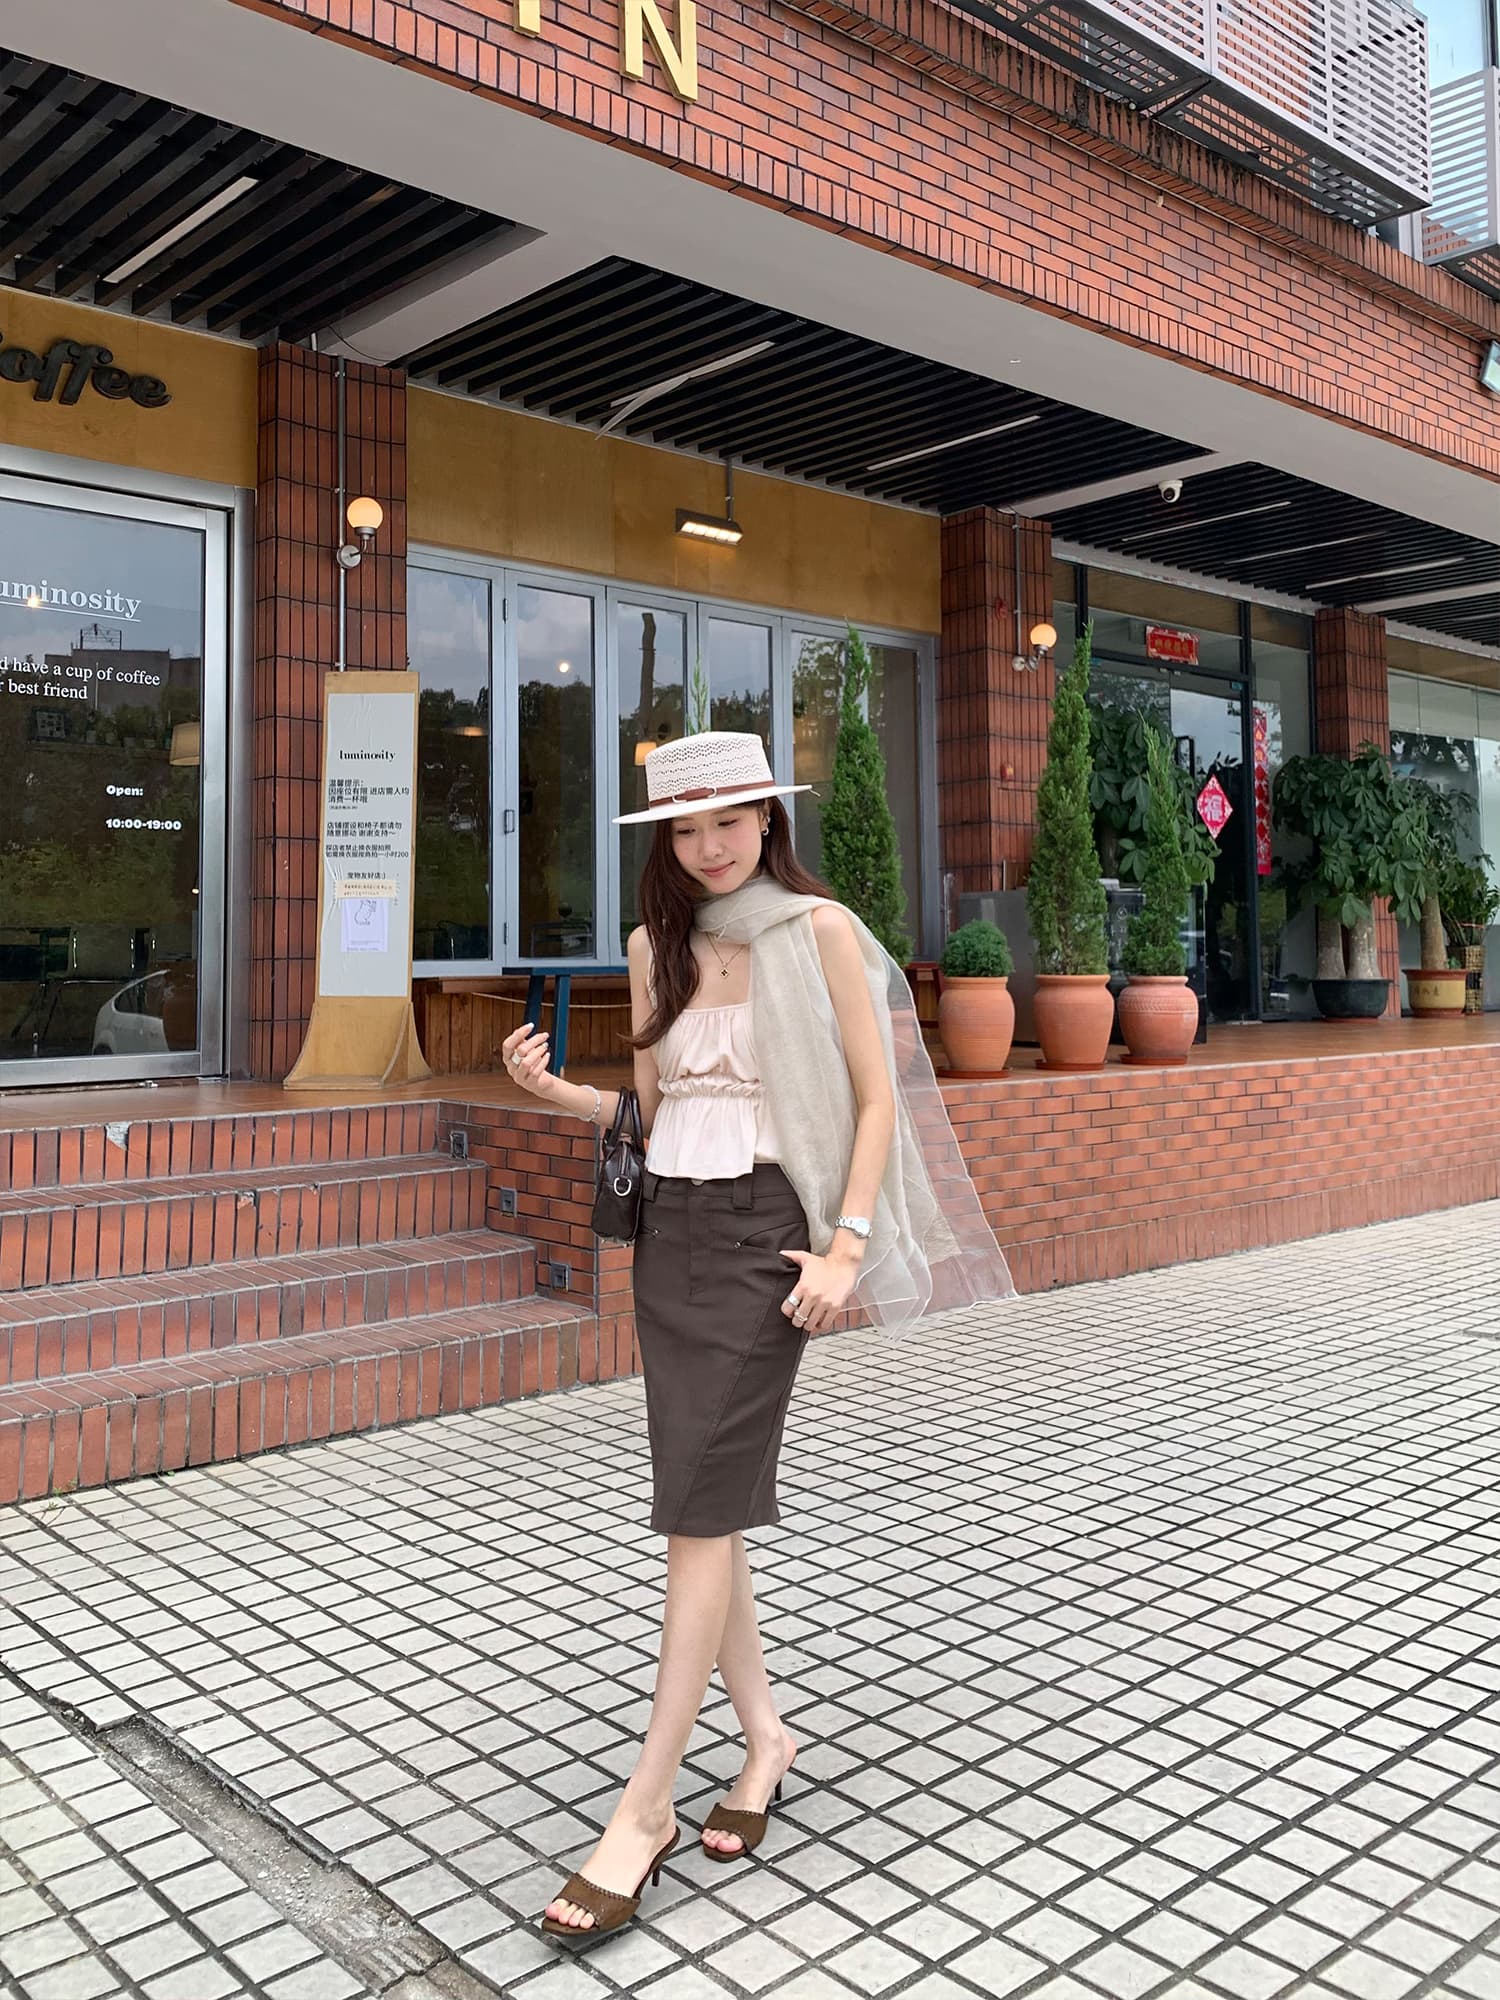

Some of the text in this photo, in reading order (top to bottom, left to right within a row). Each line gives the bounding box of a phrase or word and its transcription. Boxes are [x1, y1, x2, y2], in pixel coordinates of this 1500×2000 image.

[0, 331, 172, 408] offee
[13, 657, 49, 674] have
[53, 665, 62, 676] a
[65, 669, 93, 682] cup
[97, 667, 114, 680] of
[116, 670, 160, 686] coffee
[8, 679, 39, 695] best
[43, 682, 88, 699] friend
[106, 785, 144, 797] Open:
[105, 818, 182, 831] 10:00-19:00
